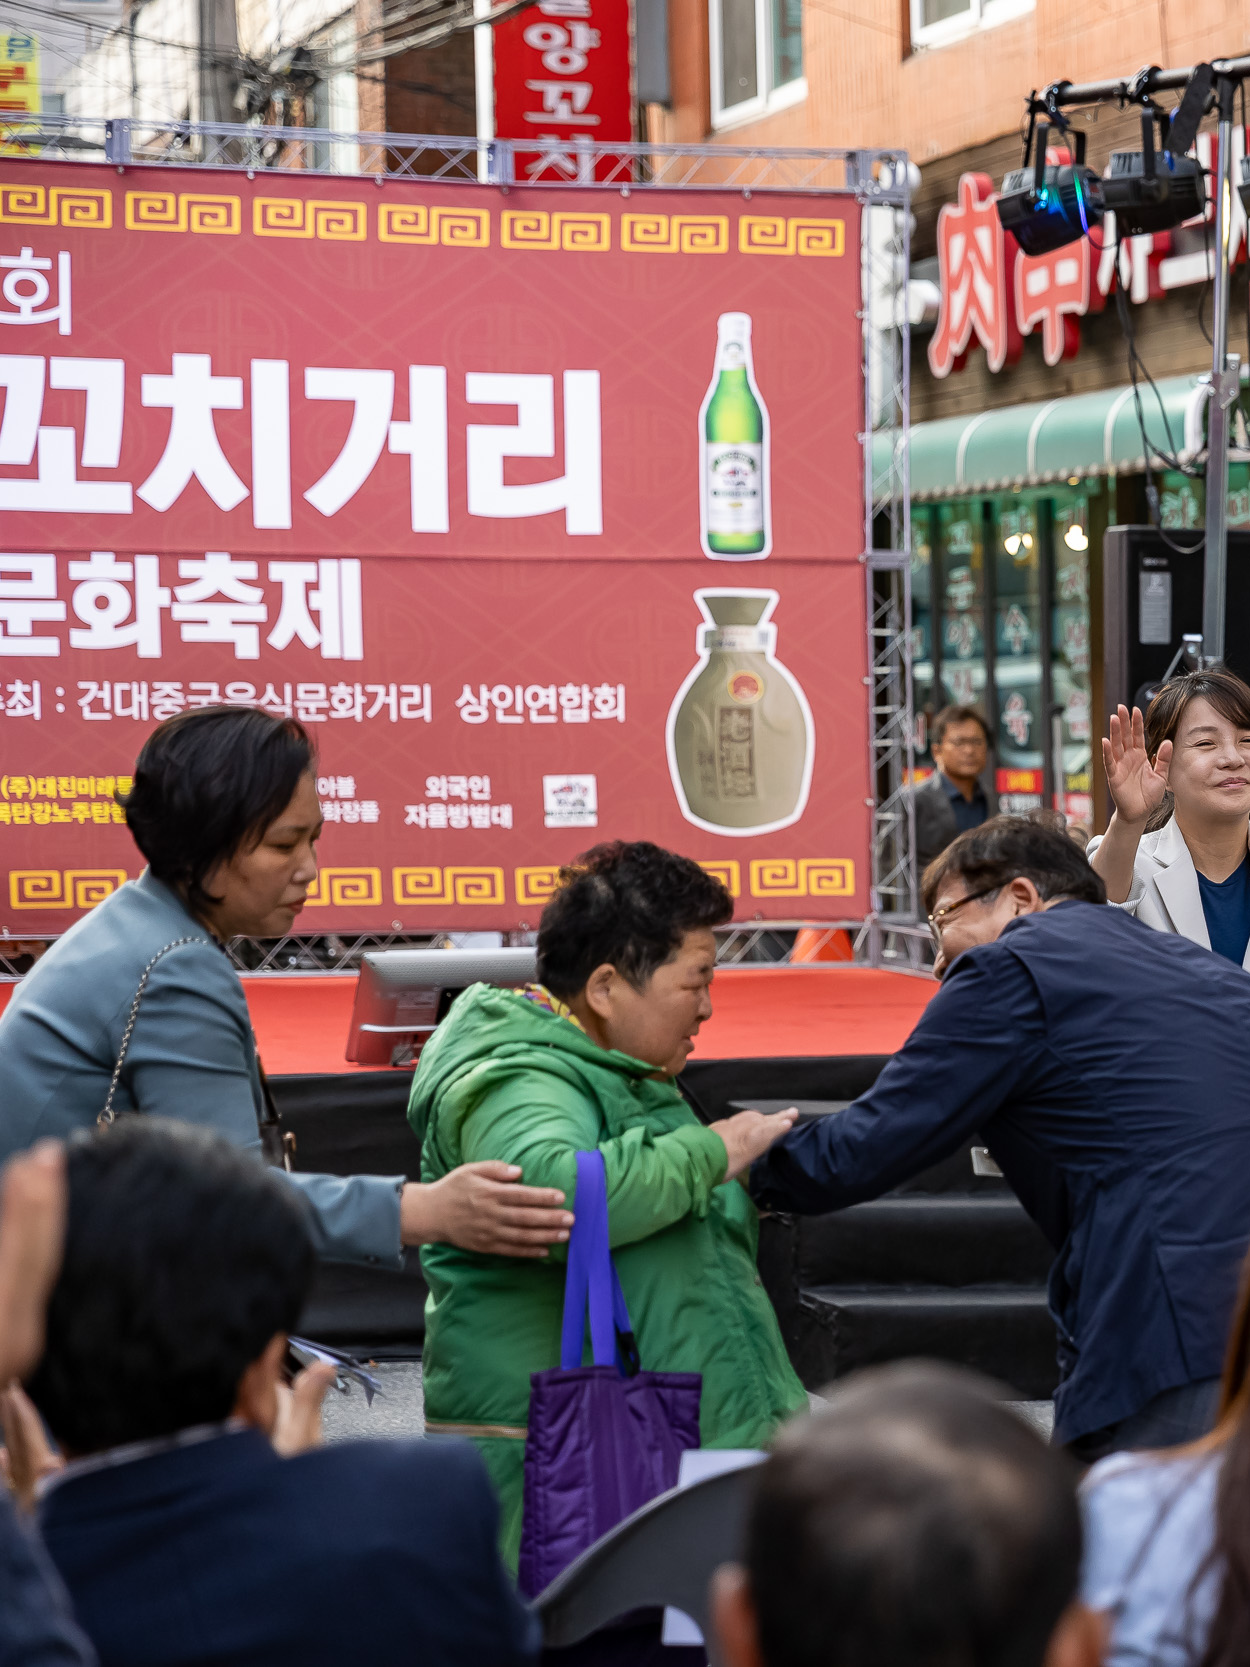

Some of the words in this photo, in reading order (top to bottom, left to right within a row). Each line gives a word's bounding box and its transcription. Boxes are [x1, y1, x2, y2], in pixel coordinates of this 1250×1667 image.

[522, 0, 602, 186] 양꼬치
[0, 246, 72, 336] 회
[0, 353, 604, 536] 꼬치거리
[0, 551, 365, 661] 문화축제
[0, 679, 42, 721] 최
[455, 681, 626, 724] 상인연합회
[318, 800, 380, 824] 화장품
